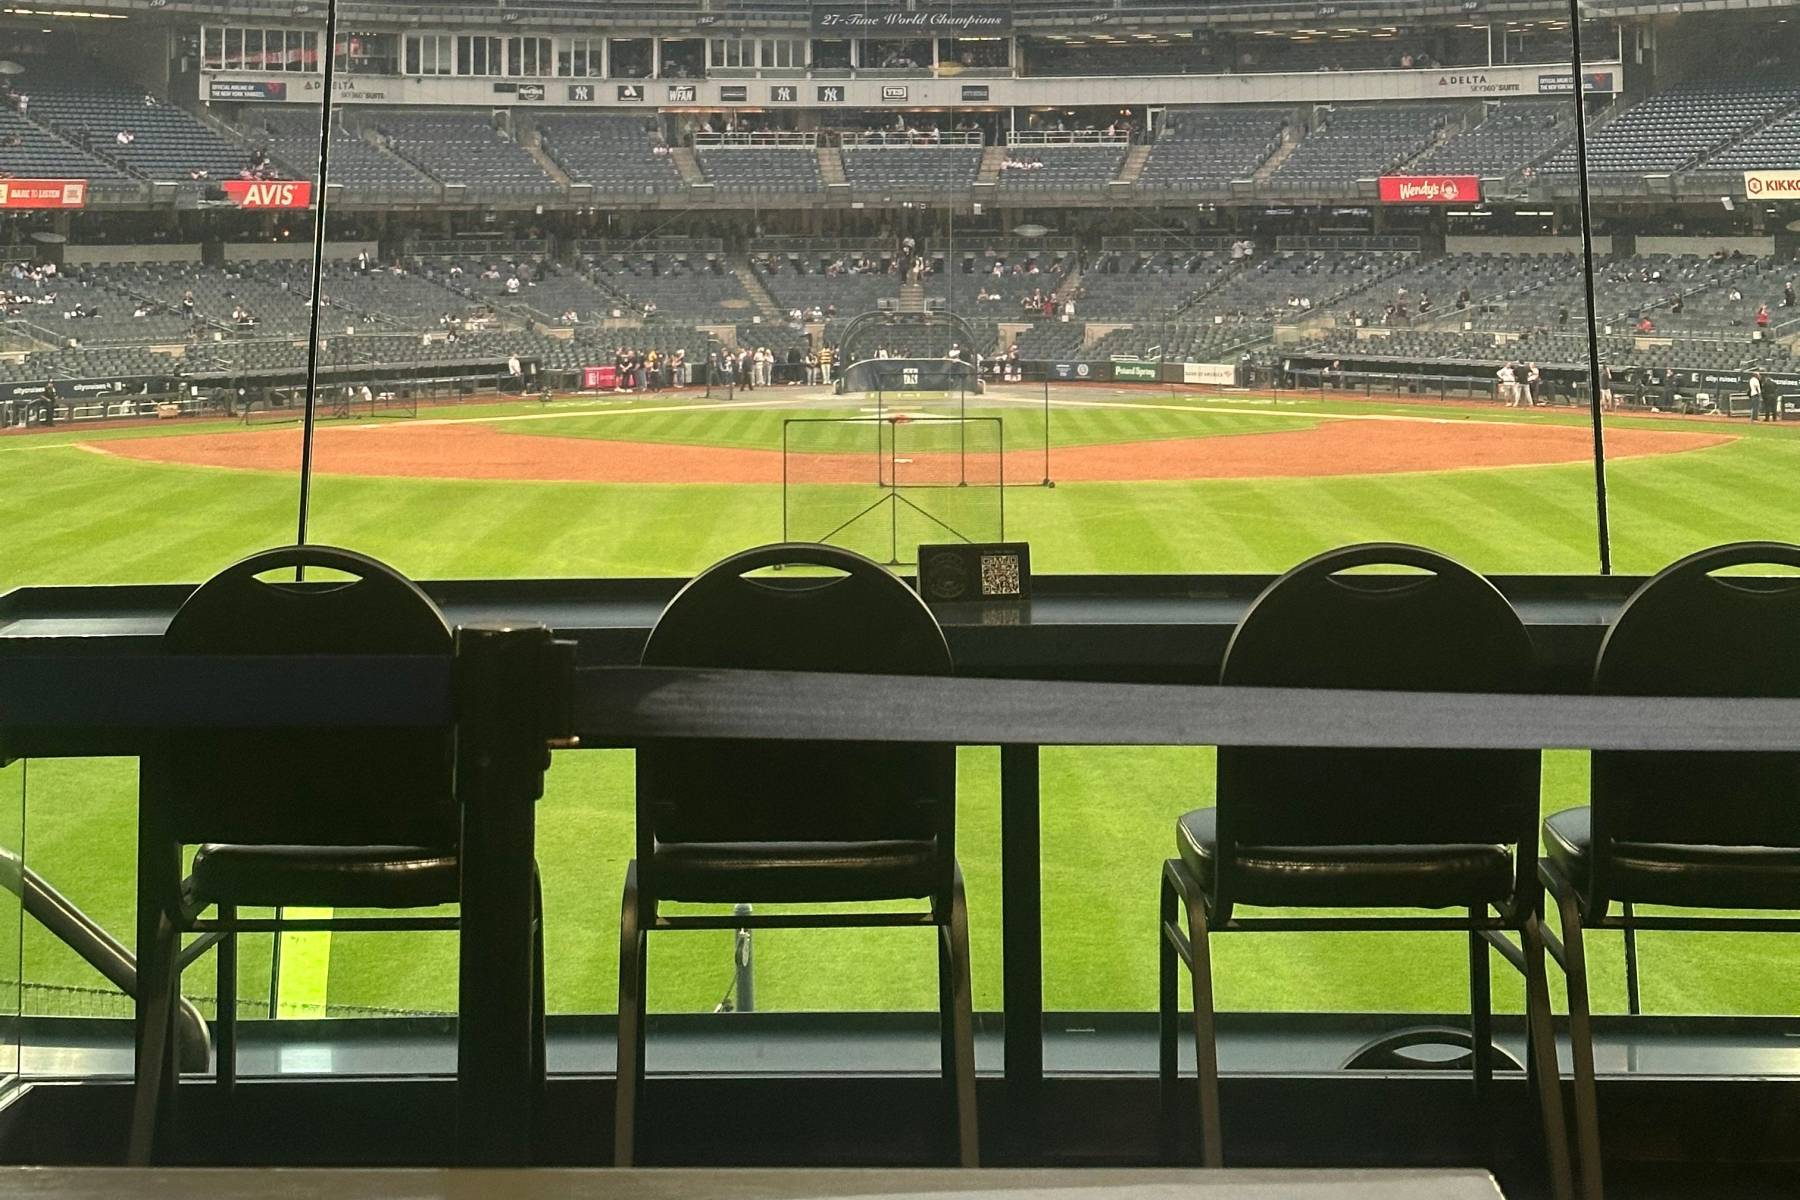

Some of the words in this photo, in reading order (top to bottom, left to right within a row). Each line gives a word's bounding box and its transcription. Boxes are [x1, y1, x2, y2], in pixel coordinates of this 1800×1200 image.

[821, 12, 879, 26] 27-Time
[884, 13, 928, 26] World
[930, 12, 1002, 29] Champions
[1450, 75, 1487, 85] DELTA
[669, 87, 693, 101] WFAN
[886, 88, 903, 96] YES
[243, 183, 294, 206] AVIS
[1400, 181, 1439, 200] Wendy's
